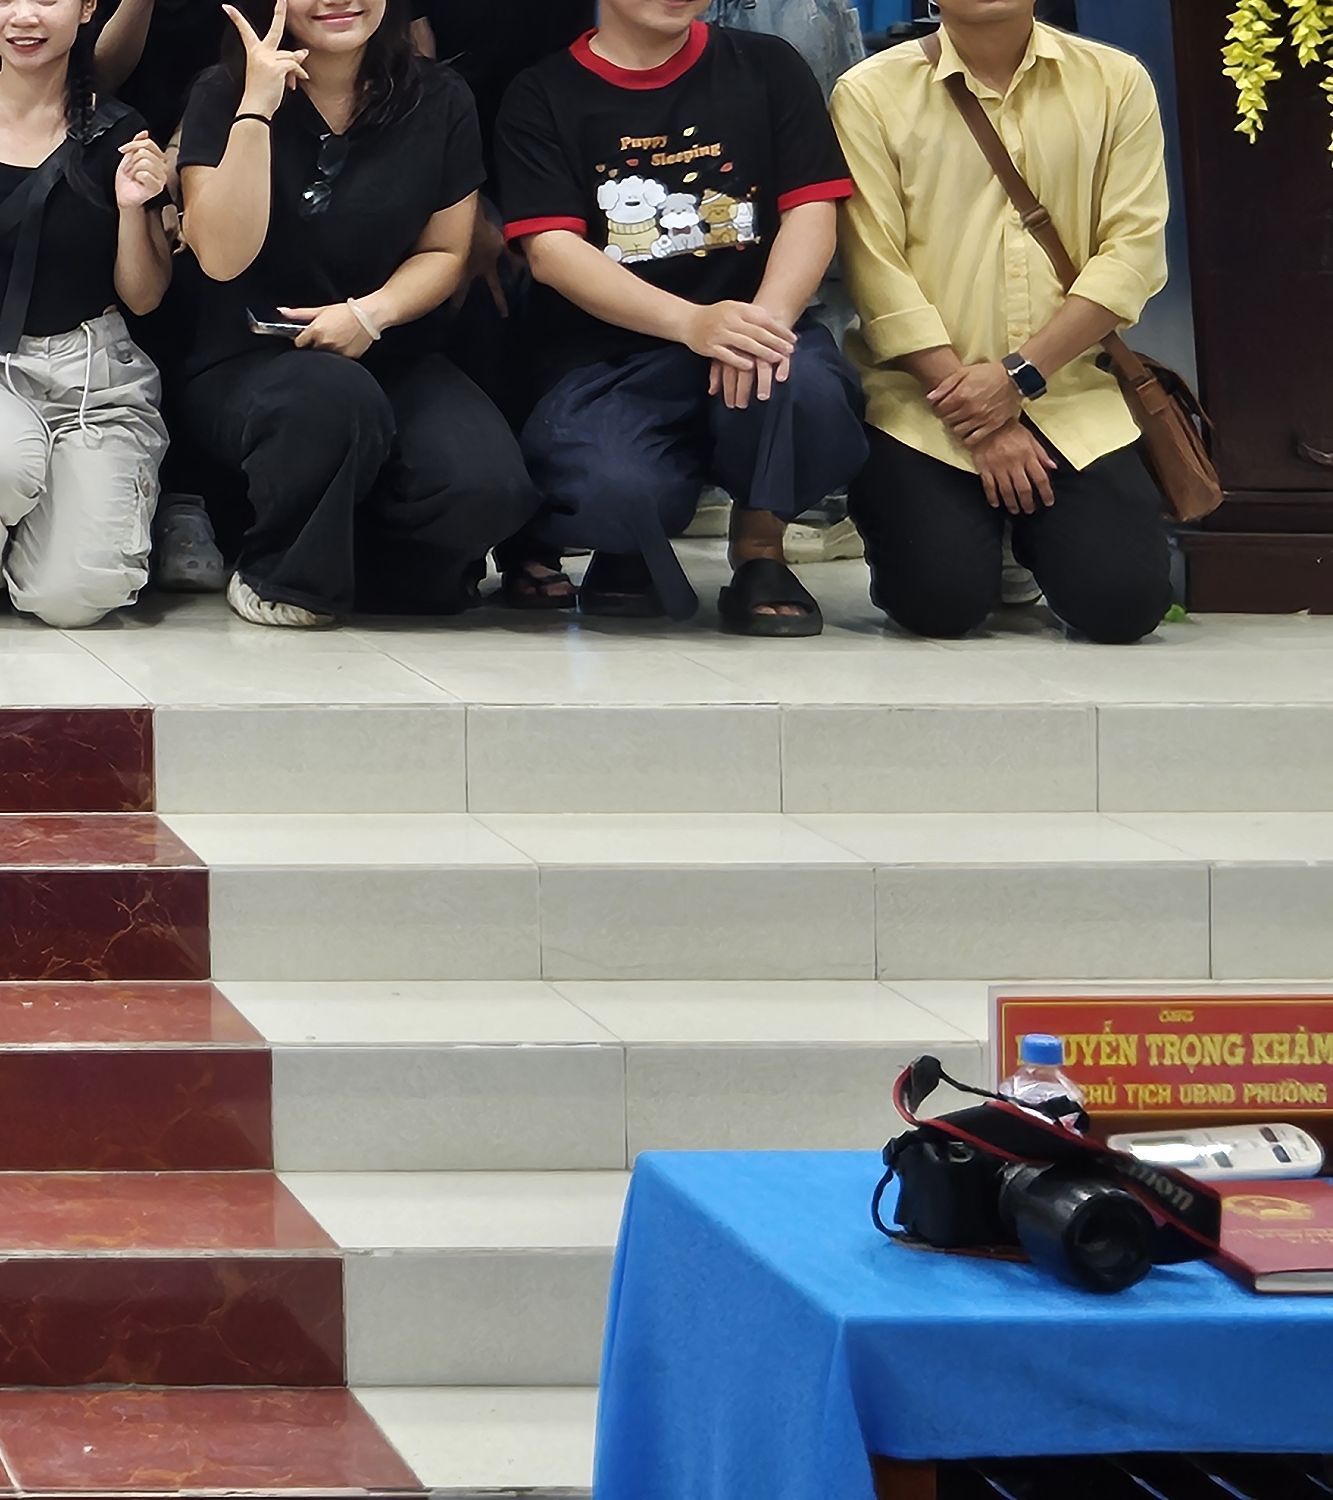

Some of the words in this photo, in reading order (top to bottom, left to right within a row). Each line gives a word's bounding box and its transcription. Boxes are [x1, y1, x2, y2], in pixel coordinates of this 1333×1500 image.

[619, 135, 668, 151] Puppy
[651, 143, 722, 166] Sleeping
[1145, 1033, 1246, 1075] TRỌNG
[1124, 1083, 1172, 1111] TỊCH
[1179, 1083, 1236, 1105] UBND
[1242, 1077, 1327, 1104] PHƯỜNG
